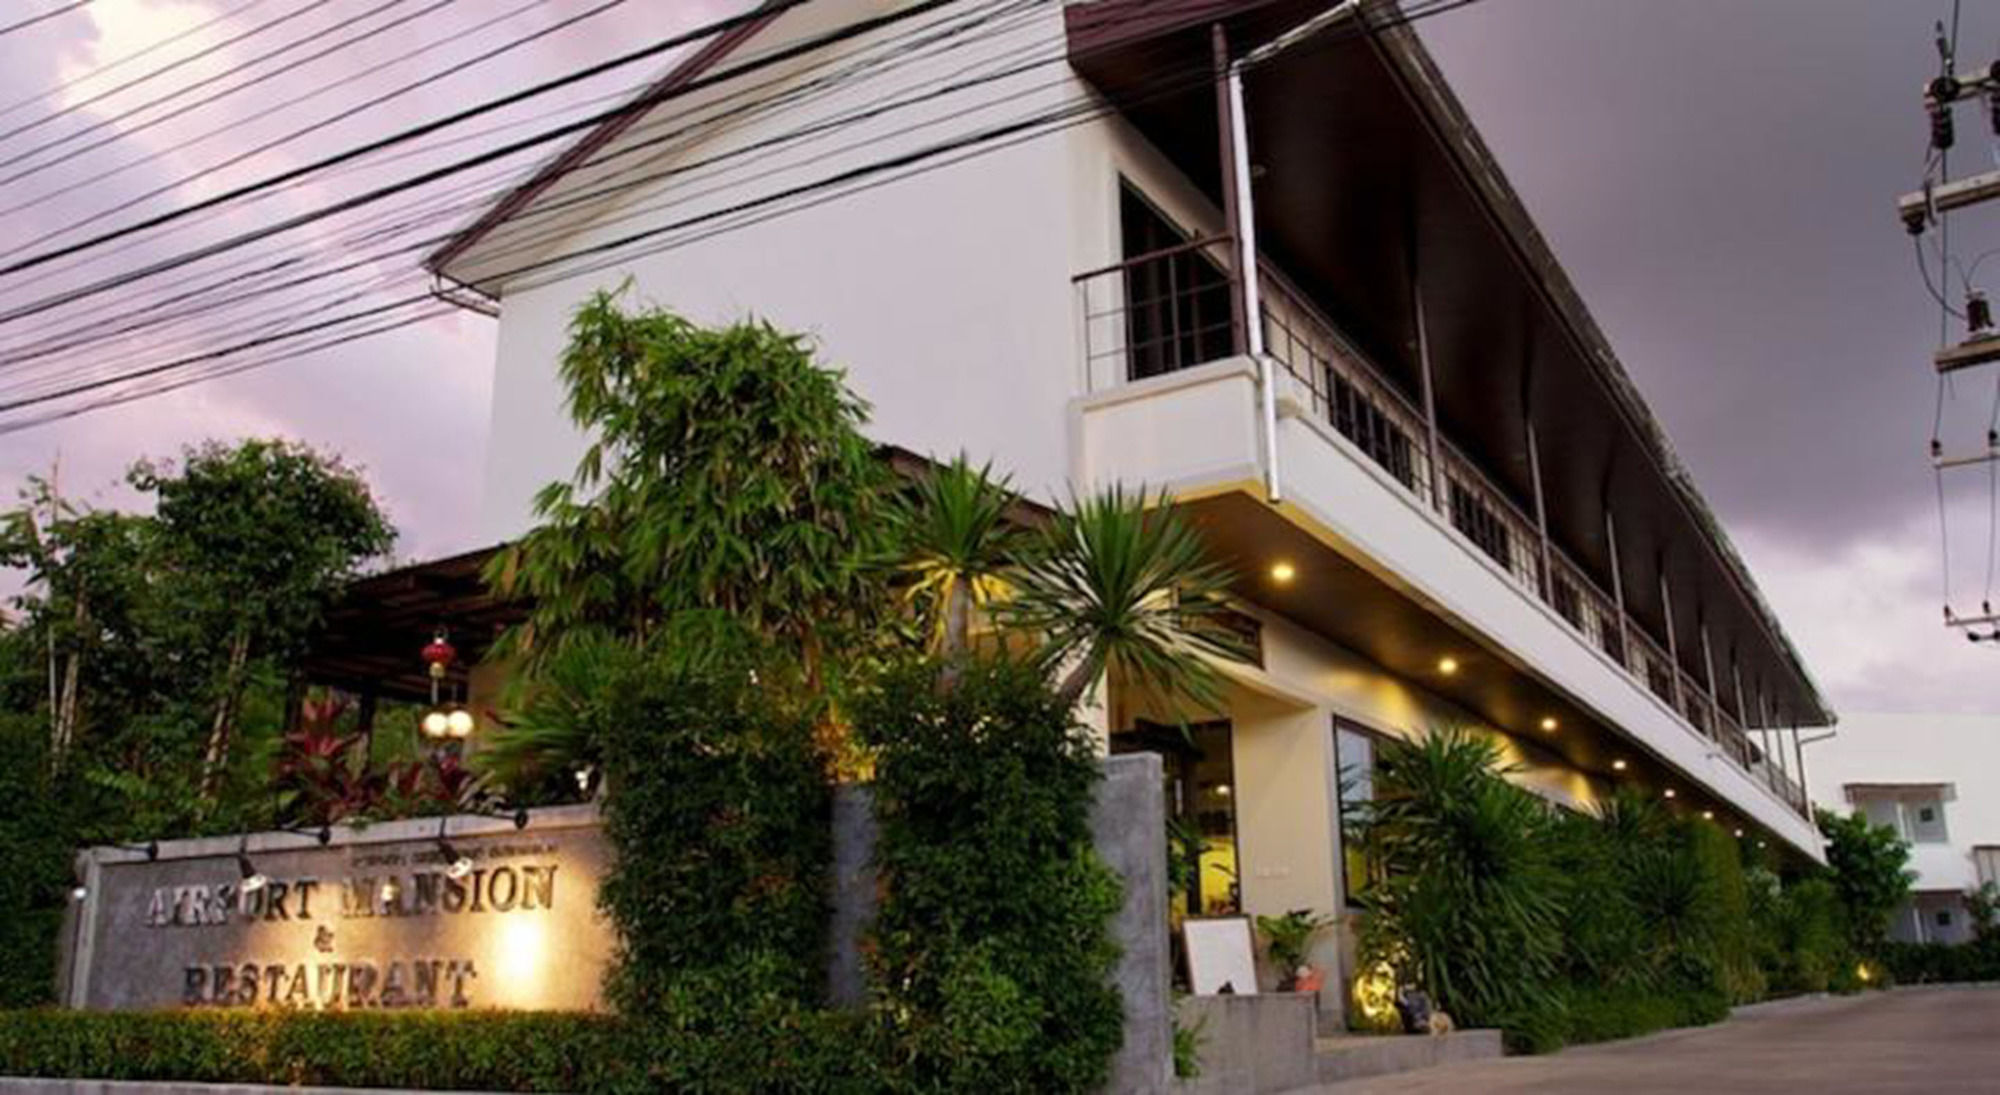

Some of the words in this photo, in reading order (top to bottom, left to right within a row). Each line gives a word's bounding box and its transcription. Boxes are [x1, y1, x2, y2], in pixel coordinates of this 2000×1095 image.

[341, 863, 560, 920] MANSION
[313, 924, 335, 953] &
[182, 957, 478, 1008] RESTAURANT
